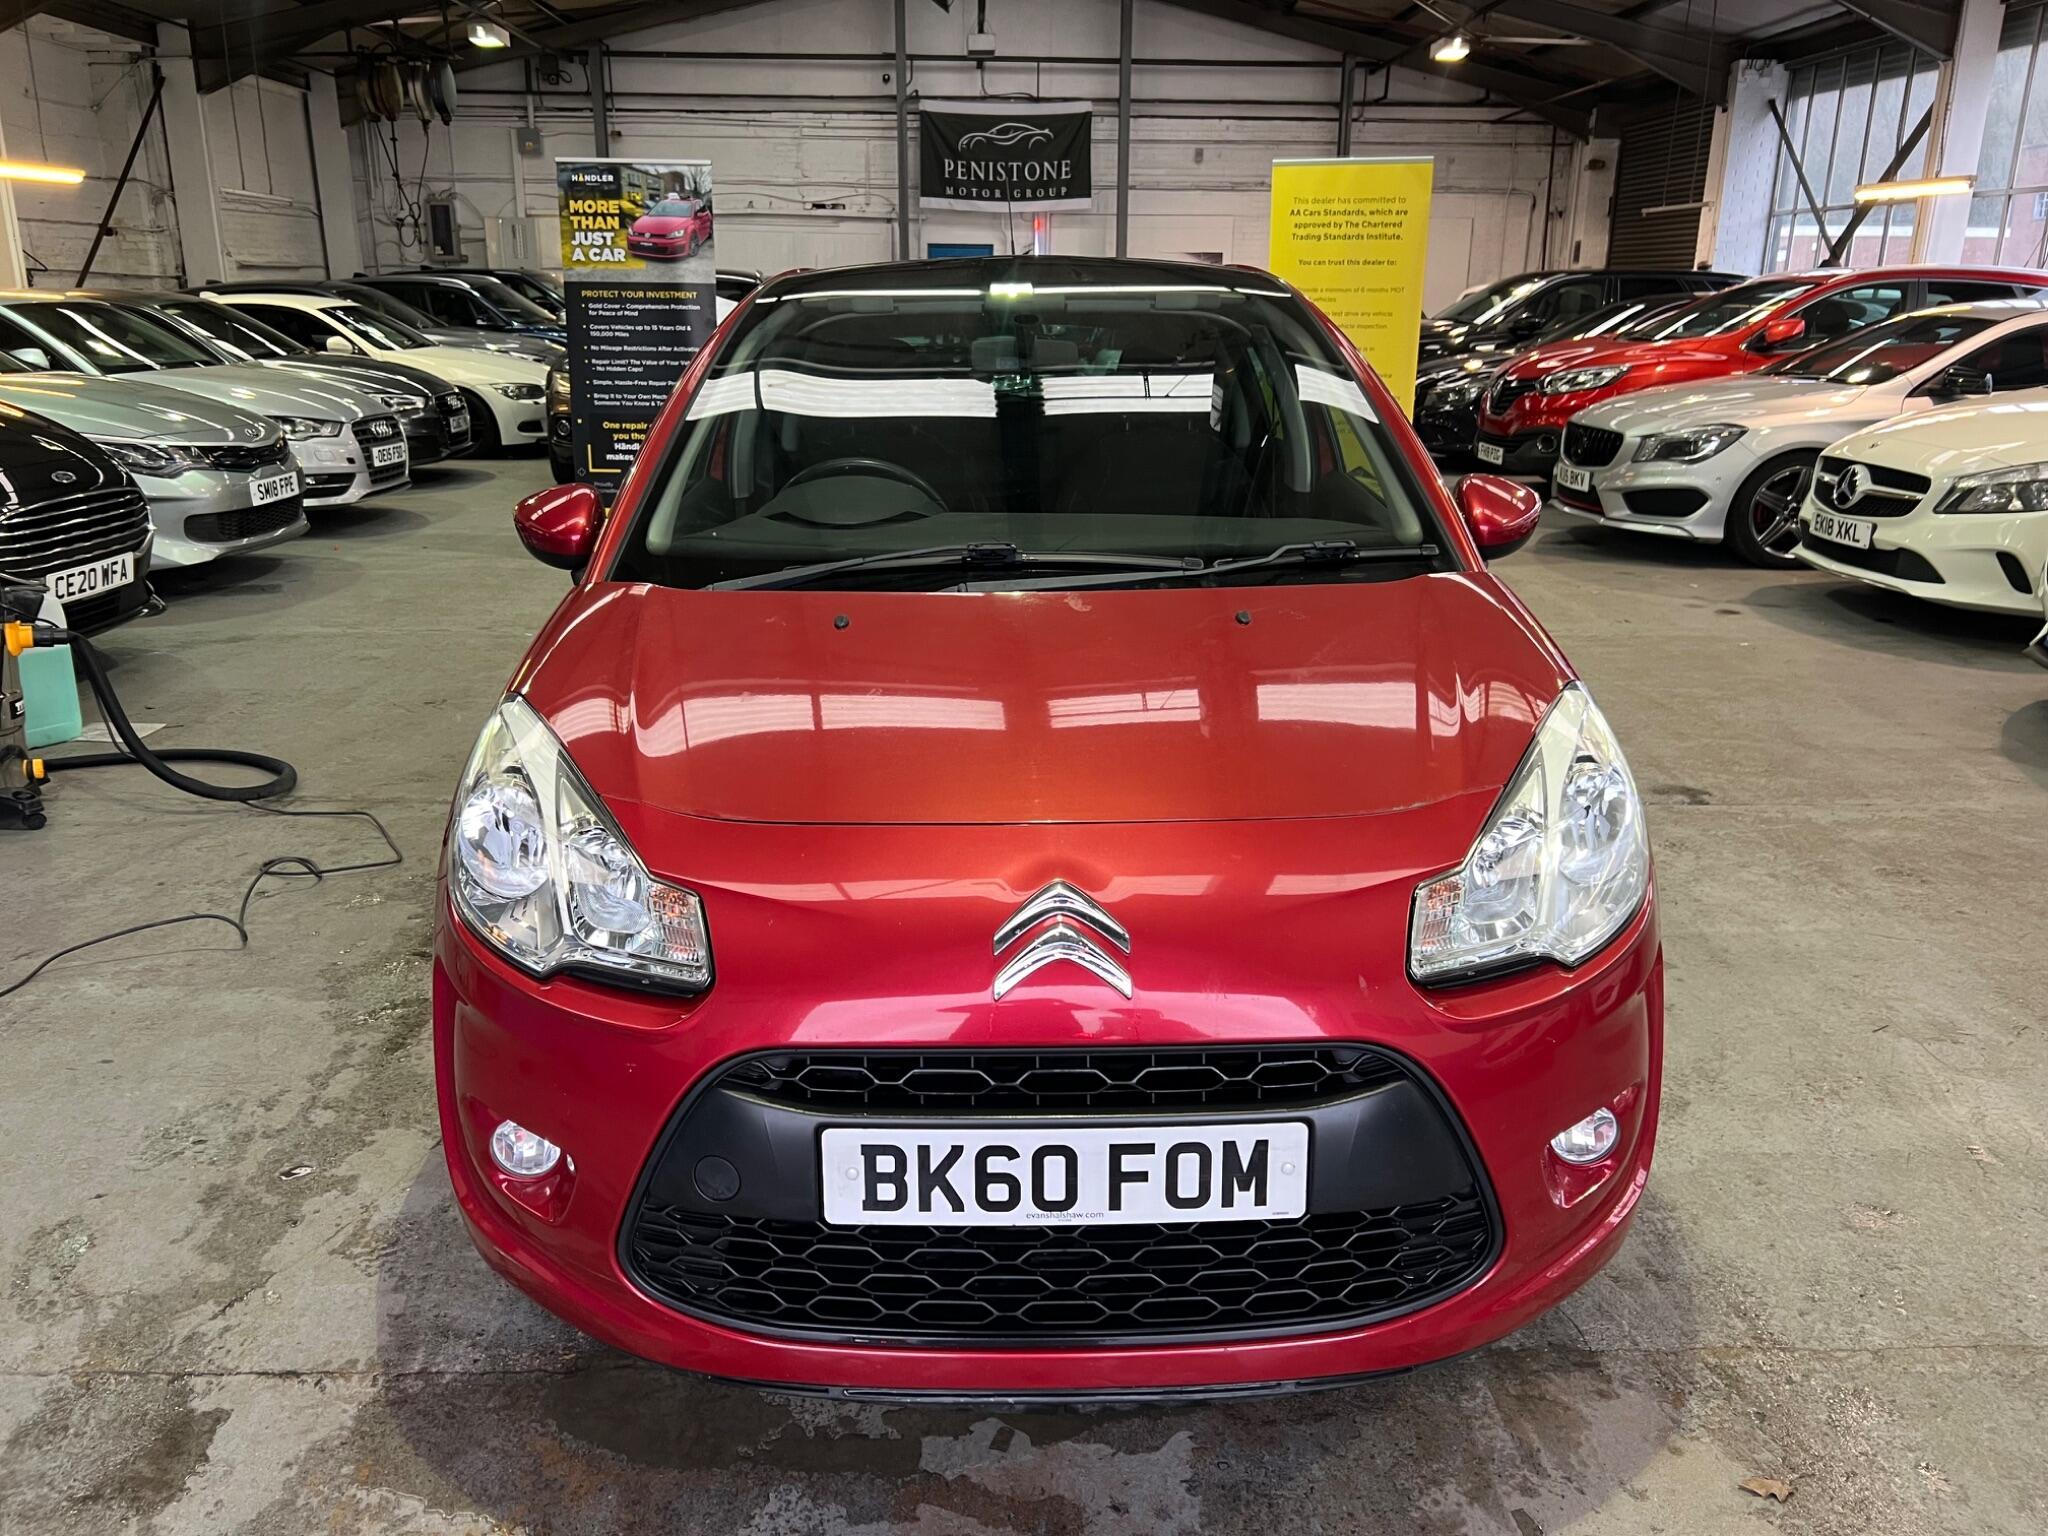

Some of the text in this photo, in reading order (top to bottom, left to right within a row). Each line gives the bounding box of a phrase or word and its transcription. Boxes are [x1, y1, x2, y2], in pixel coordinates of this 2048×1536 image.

[944, 158, 1072, 182] PENISTONE
[945, 186, 1068, 198] MOTOR GROUP
[1293, 197, 1309, 205] This
[1311, 197, 1336, 205] dealer
[1338, 197, 1351, 205] has
[1353, 196, 1396, 204] committed
[569, 200, 620, 214] MORE
[1290, 209, 1409, 218] AA Cars Standards, which are
[569, 216, 620, 230] THAN
[1294, 222, 1332, 230] approved
[1333, 221, 1343, 230] by
[571, 232, 615, 245] JUST
[1292, 233, 1404, 242] Trading Standards Institute.
[572, 248, 626, 262] A CAR
[581, 290, 619, 298] PROTECT
[646, 291, 698, 299] INVESTMENT
[602, 421, 620, 429] One
[622, 421, 648, 431] repair
[613, 433, 630, 441] you
[605, 453, 634, 461] makes
[257, 475, 295, 501] SM18 FPE
[1814, 513, 1860, 543] EK18 XKL
[55, 558, 128, 600] CE20 WFA
[860, 1139, 1270, 1213] BK60 FOM
[1026, 1210, 1104, 1219] evanshalshaw.com
